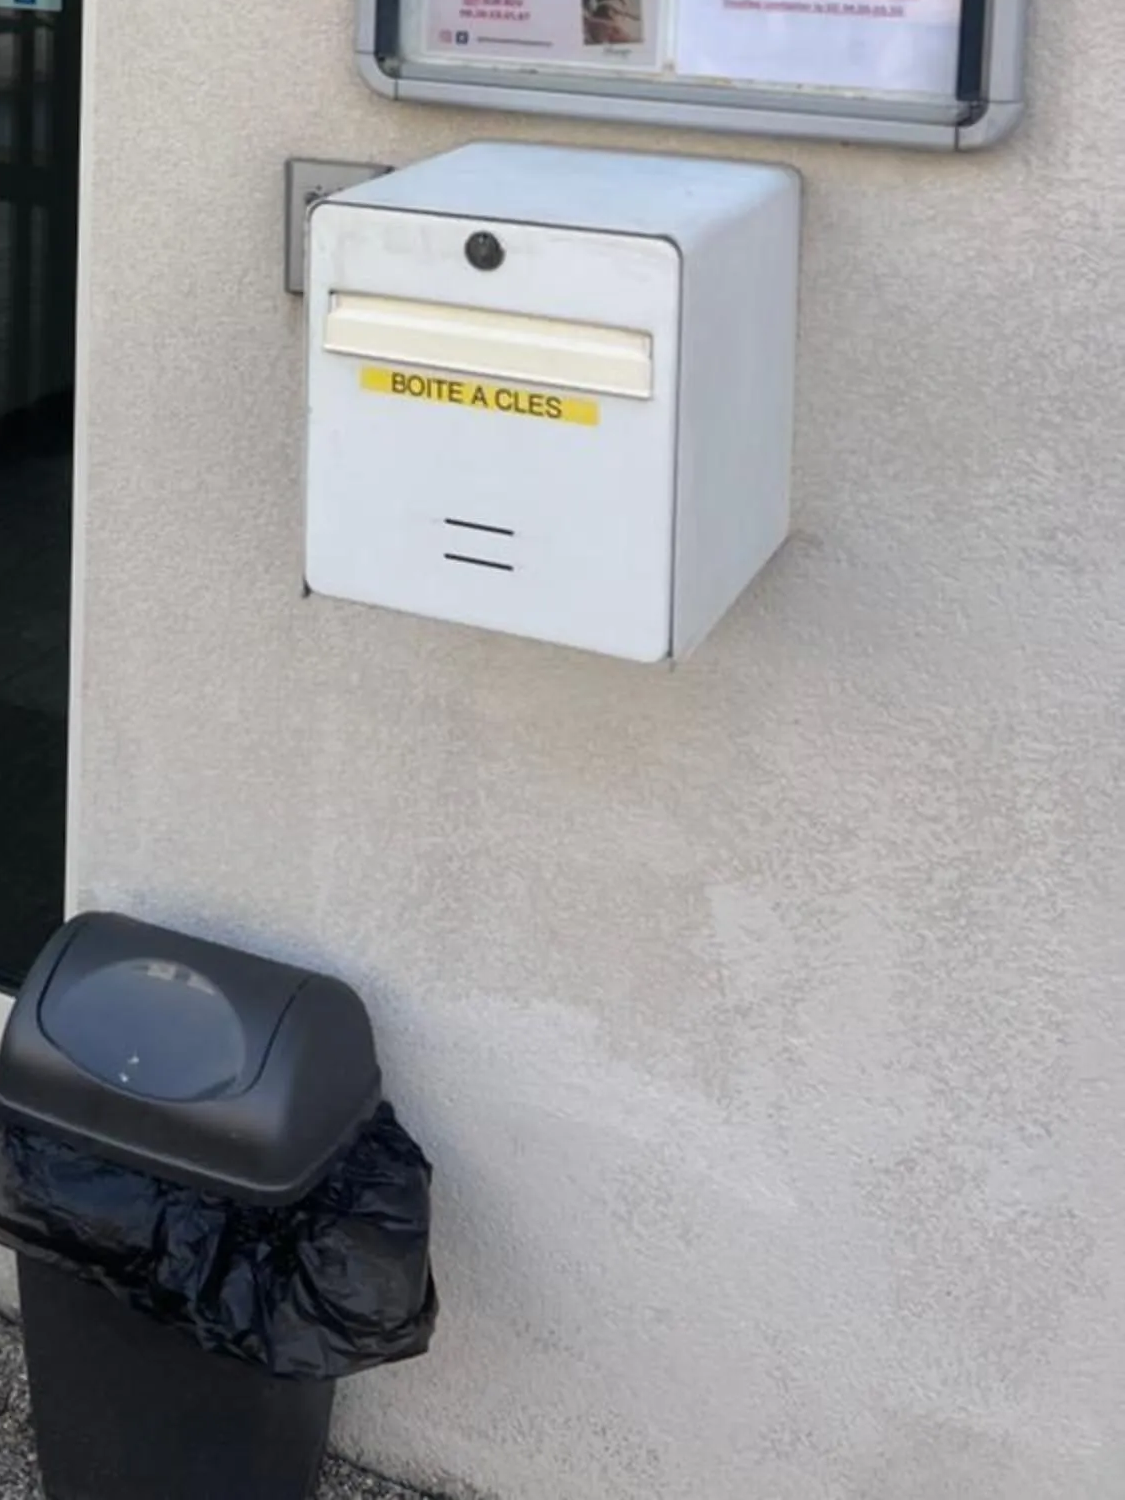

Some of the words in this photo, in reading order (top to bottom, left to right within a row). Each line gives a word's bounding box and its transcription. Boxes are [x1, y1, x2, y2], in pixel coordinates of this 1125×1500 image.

[390, 372, 465, 405] BOITE
[471, 385, 489, 408] A
[494, 387, 563, 420] CLES
